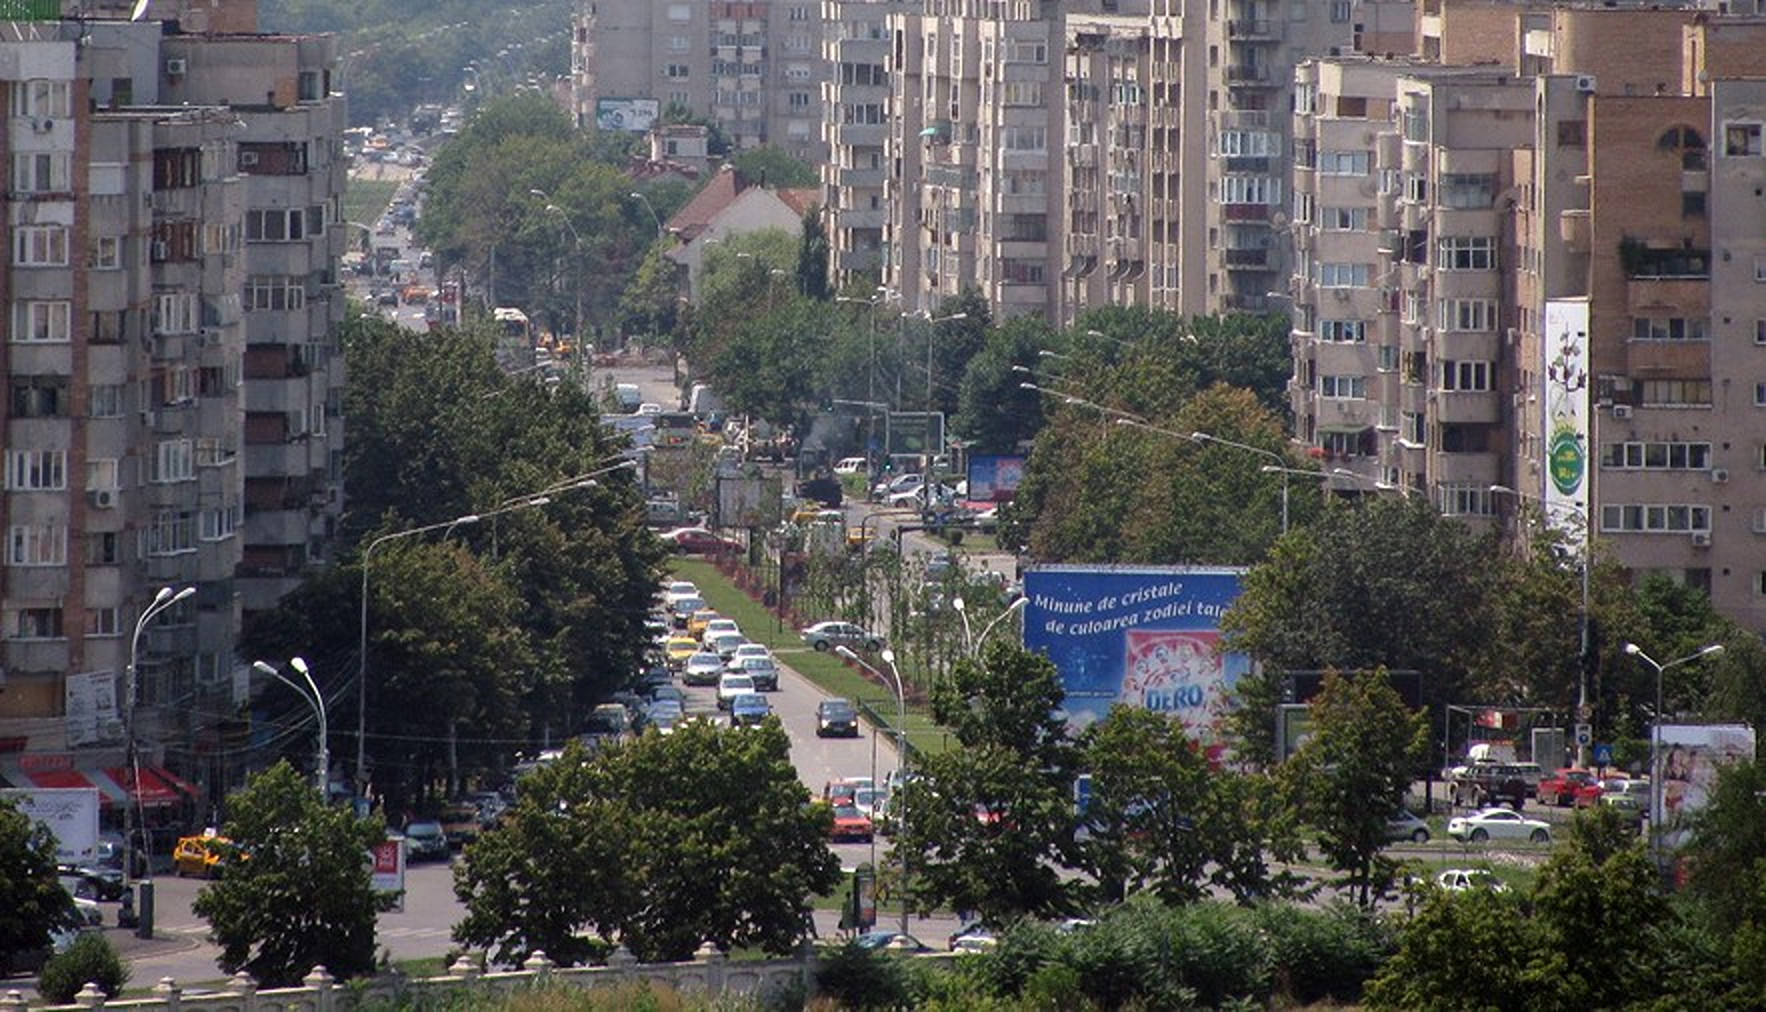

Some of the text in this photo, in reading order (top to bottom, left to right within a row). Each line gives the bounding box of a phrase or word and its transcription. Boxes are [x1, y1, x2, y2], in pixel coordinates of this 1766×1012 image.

[1034, 582, 1183, 613] Minune de cristale
[1045, 619, 1065, 635] de
[1069, 613, 1139, 635] culoarea
[1143, 600, 1193, 623] zodiei
[1146, 684, 1203, 711] DERO
